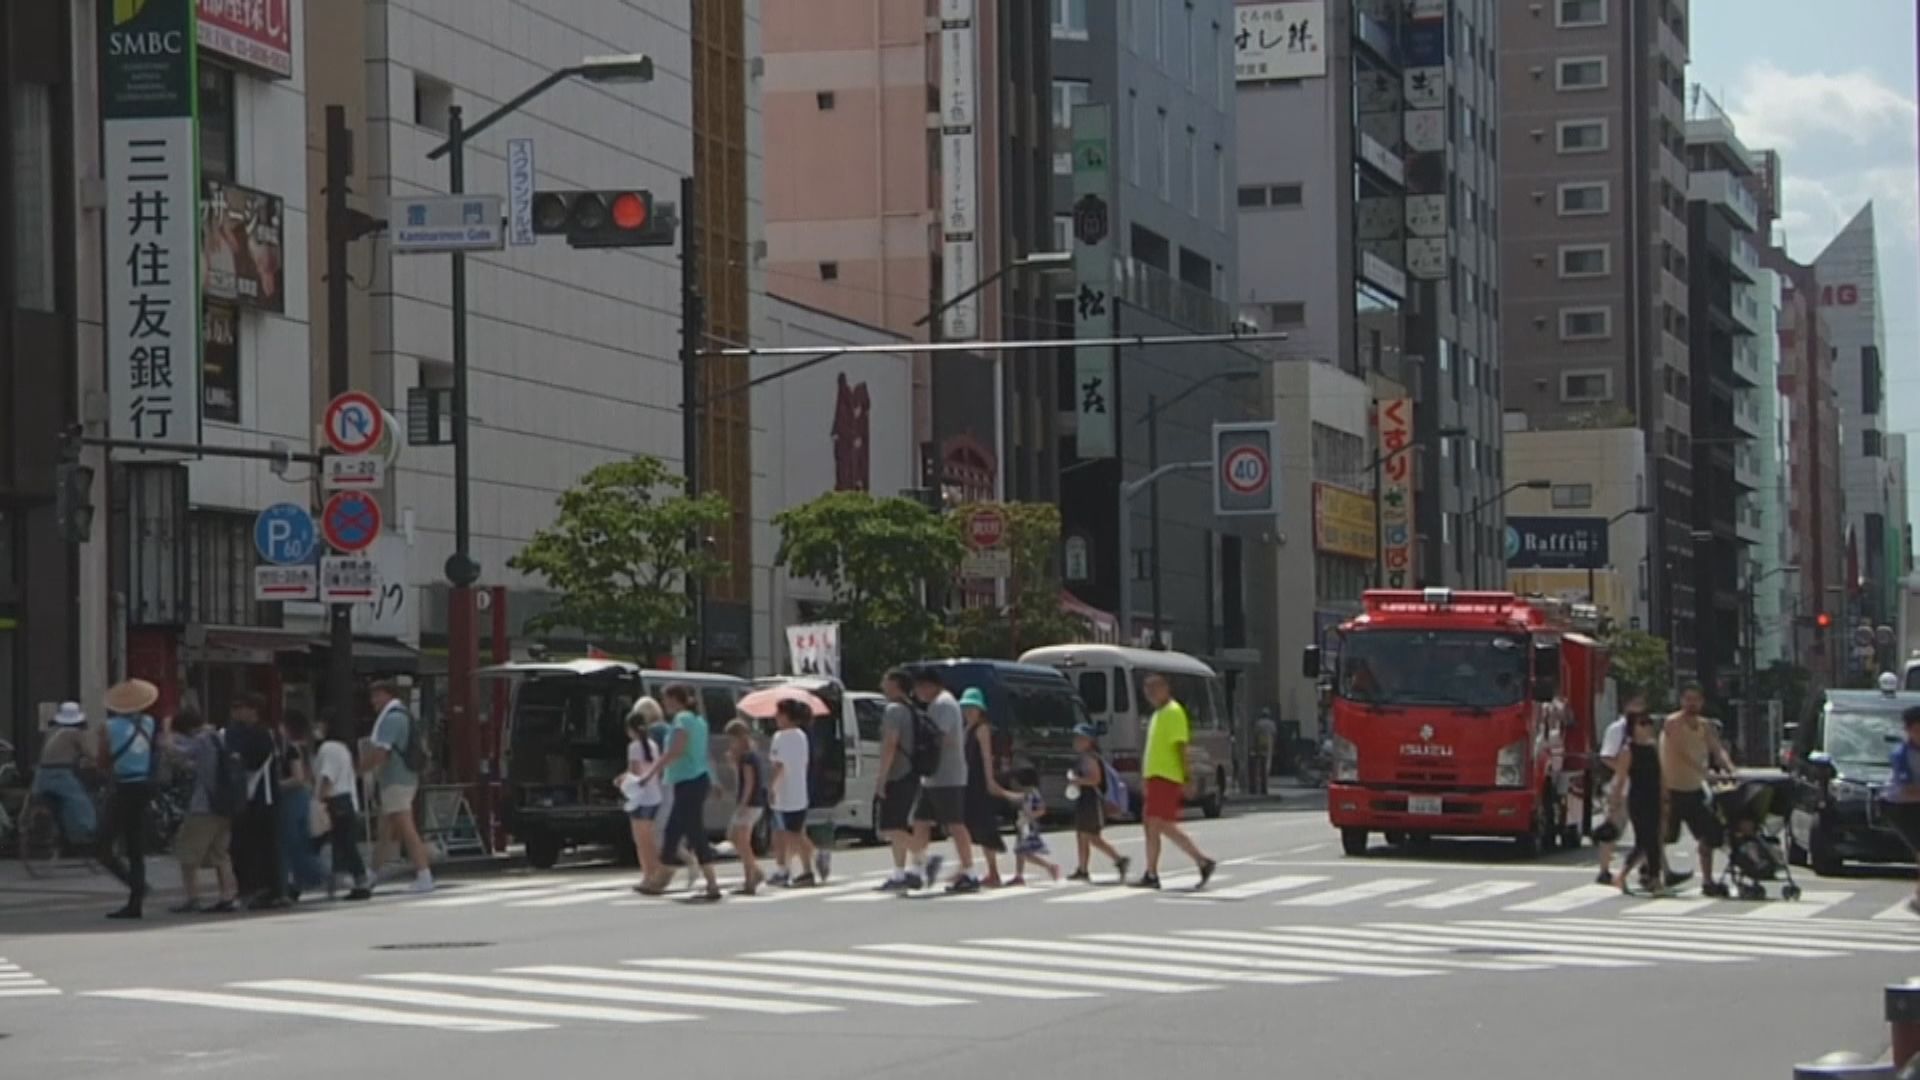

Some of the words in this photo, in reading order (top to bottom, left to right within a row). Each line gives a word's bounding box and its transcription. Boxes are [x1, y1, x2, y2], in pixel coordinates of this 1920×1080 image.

[110, 31, 182, 56] SMBC
[467, 228, 491, 241] Gate
[126, 139, 173, 453] 三井住友銀行
[1384, 401, 1407, 481] くすり
[1234, 460, 1259, 480] 40
[268, 519, 291, 557] P
[1525, 533, 1598, 551] Raffin
[1399, 743, 1454, 757] ISUZU
